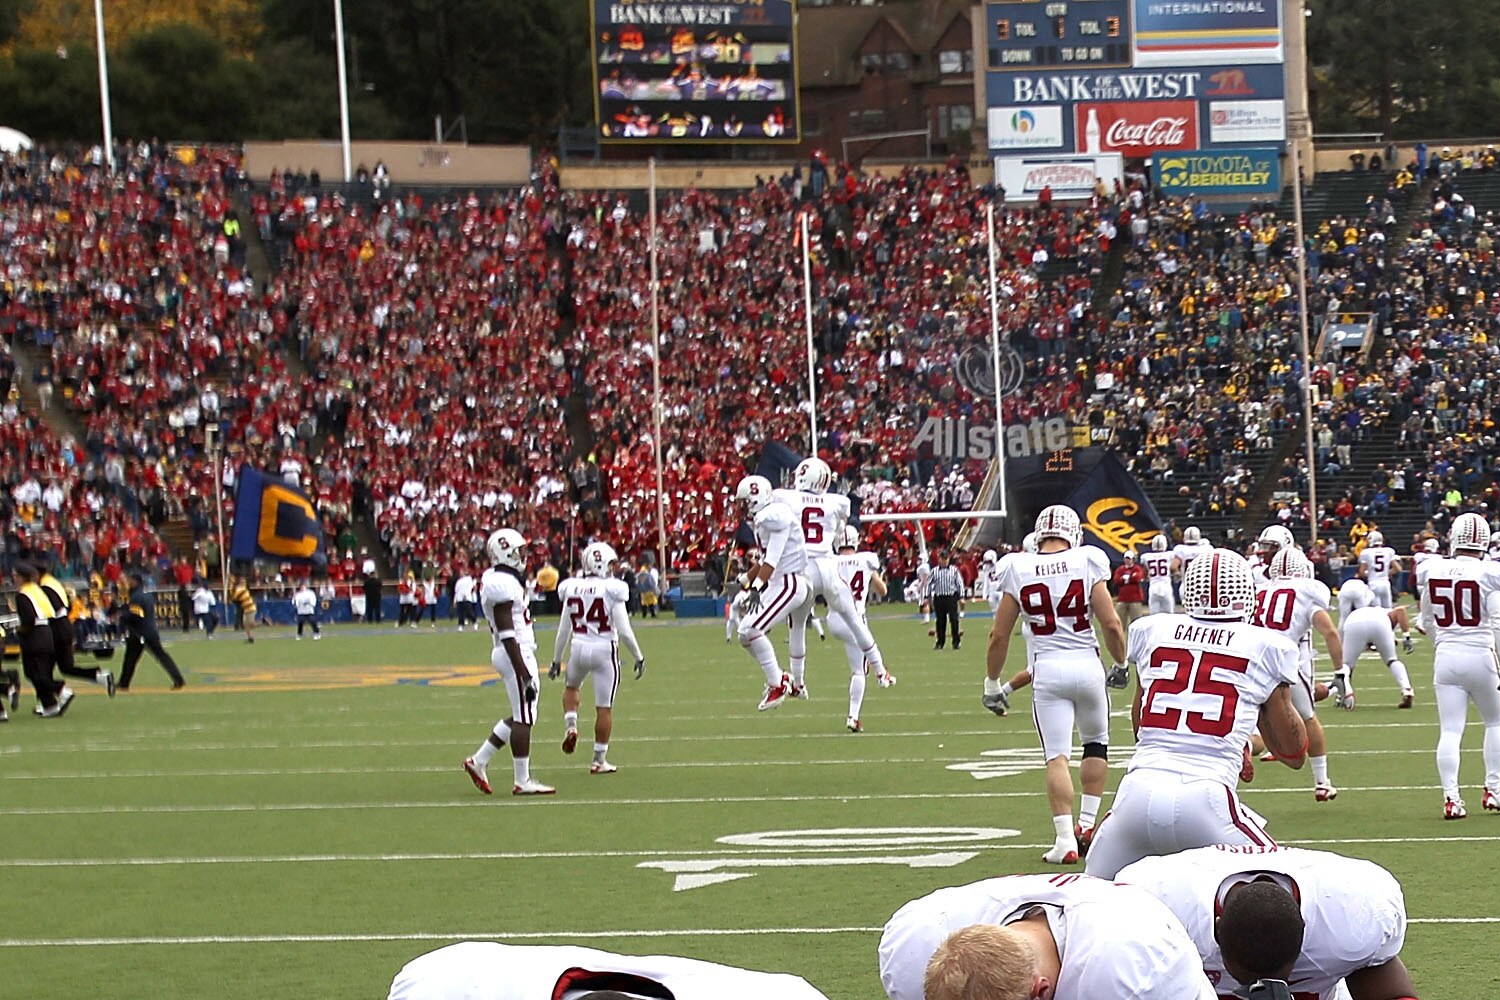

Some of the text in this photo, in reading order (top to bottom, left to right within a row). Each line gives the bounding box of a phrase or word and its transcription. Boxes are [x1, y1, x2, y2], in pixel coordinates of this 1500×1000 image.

[610, 5, 662, 24] BANK
[681, 5, 733, 24] WEST
[1149, 2, 1265, 15] INTERNATIONAL
[1002, 49, 1031, 63] DOWN
[1013, 72, 1200, 102] BANK OF WEST
[1092, 86, 1123, 99] THE
[1106, 116, 1188, 147] Coca-Cola
[1188, 156, 1271, 173] TOYOTA OF
[1189, 172, 1271, 187] BERKELEY
[910, 417, 1069, 460] Allstate
[749, 483, 759, 495] S
[258, 484, 319, 559] C
[801, 507, 825, 544] 6
[1035, 561, 1069, 577] KEISER
[1148, 559, 1168, 578] 56
[1374, 555, 1385, 573] 5
[1020, 578, 1091, 636] 94
[1428, 578, 1482, 628] 50
[567, 596, 611, 634] 24
[1174, 624, 1236, 647] GAFFNEY
[1140, 646, 1250, 738] 25
